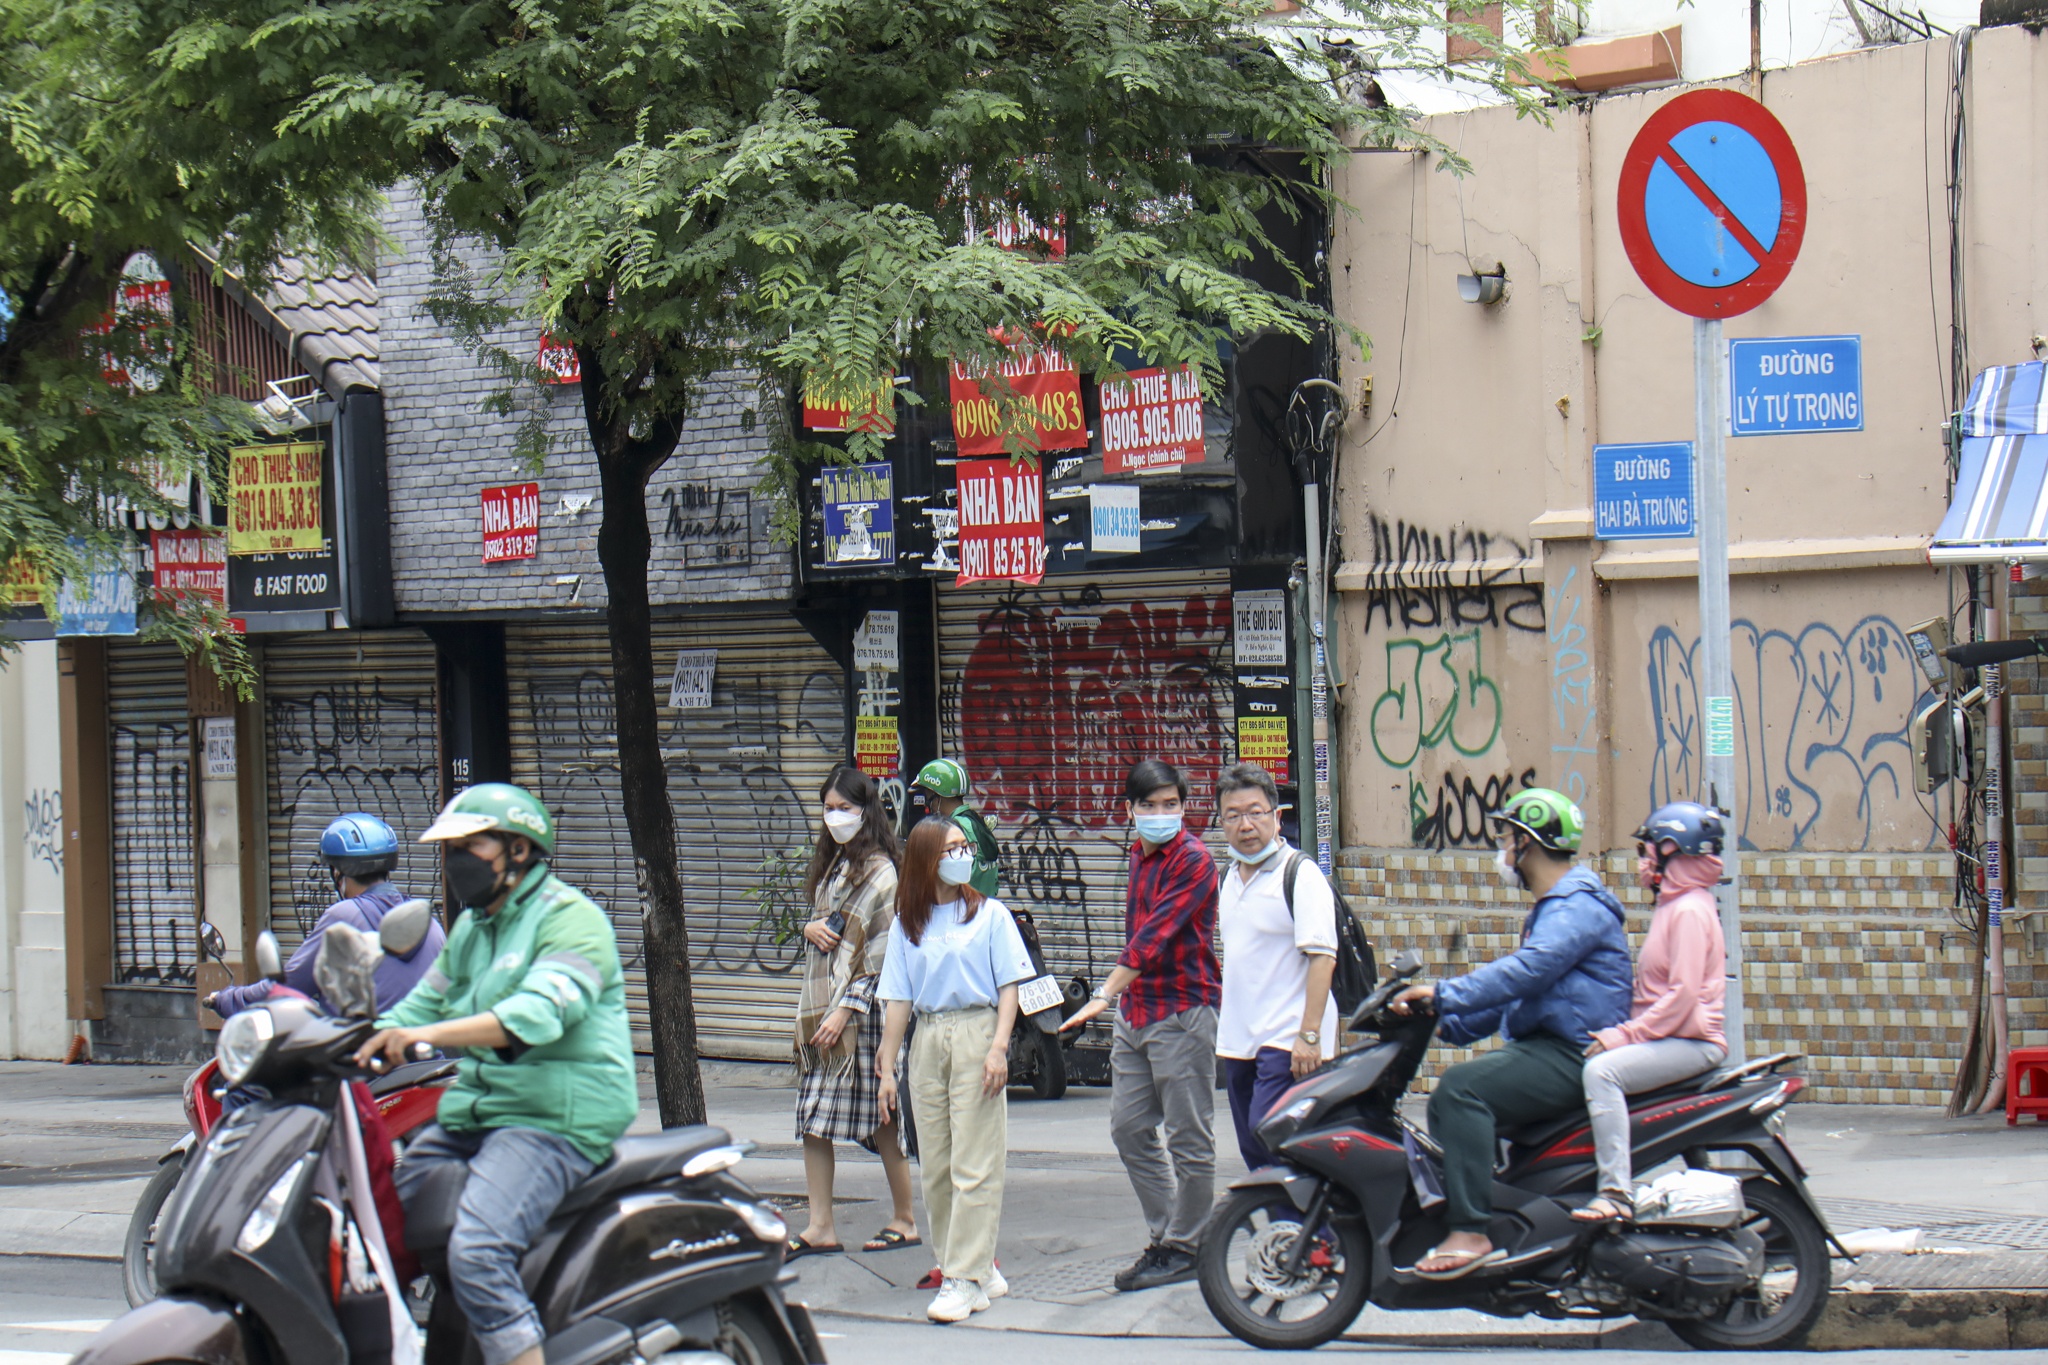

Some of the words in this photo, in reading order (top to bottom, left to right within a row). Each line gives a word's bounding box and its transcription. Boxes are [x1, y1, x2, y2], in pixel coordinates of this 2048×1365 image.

[1759, 349, 1834, 376] ĐƯỜNG
[1101, 380, 1129, 411] CHO
[1738, 387, 1758, 424] LÝ
[1764, 392, 1790, 428] TỰ
[1794, 392, 1858, 427] TRỌNG
[1042, 390, 1082, 432] 083
[1103, 401, 1202, 452] 0906.905.006
[235, 456, 259, 486] CHO
[1122, 453, 1146, 469] A.Ngọc
[1148, 449, 1169, 466] (chính
[1614, 454, 1671, 481] ĐƯỜNG
[483, 489, 511, 533] NHÀ
[513, 486, 538, 529] BÁN
[960, 466, 1000, 526] NHÀ
[1002, 464, 1040, 524] BÁN
[1600, 500, 1620, 528] HAI
[1624, 491, 1642, 527] BÀ
[1643, 495, 1688, 526] TRƯNG
[1093, 506, 1110, 537] 0901
[1111, 506, 1119, 537] 34
[1121, 506, 1129, 538] 35
[1130, 507, 1138, 538] 35
[179, 538, 199, 563] CHO
[484, 538, 504, 560] 0902
[506, 536, 522, 557] 319
[524, 534, 538, 555] 257
[962, 538, 990, 577] 0901
[994, 537, 1008, 576] 85
[1011, 536, 1026, 575] 25
[1028, 536, 1043, 574] 78
[254, 577, 263, 596] &
[266, 575, 292, 595] FAST
[295, 573, 328, 594] FOOD
[1237, 602, 1251, 631] THẾ
[1253, 604, 1267, 631] GIỚI
[1269, 604, 1282, 631] BÚT
[681, 656, 692, 667] CHO
[1240, 721, 1248, 729] CTY
[452, 758, 469, 776] 115
[924, 773, 941, 787] Grab
[506, 806, 548, 835] Grab
[1022, 990, 1060, 1012] 580.81
